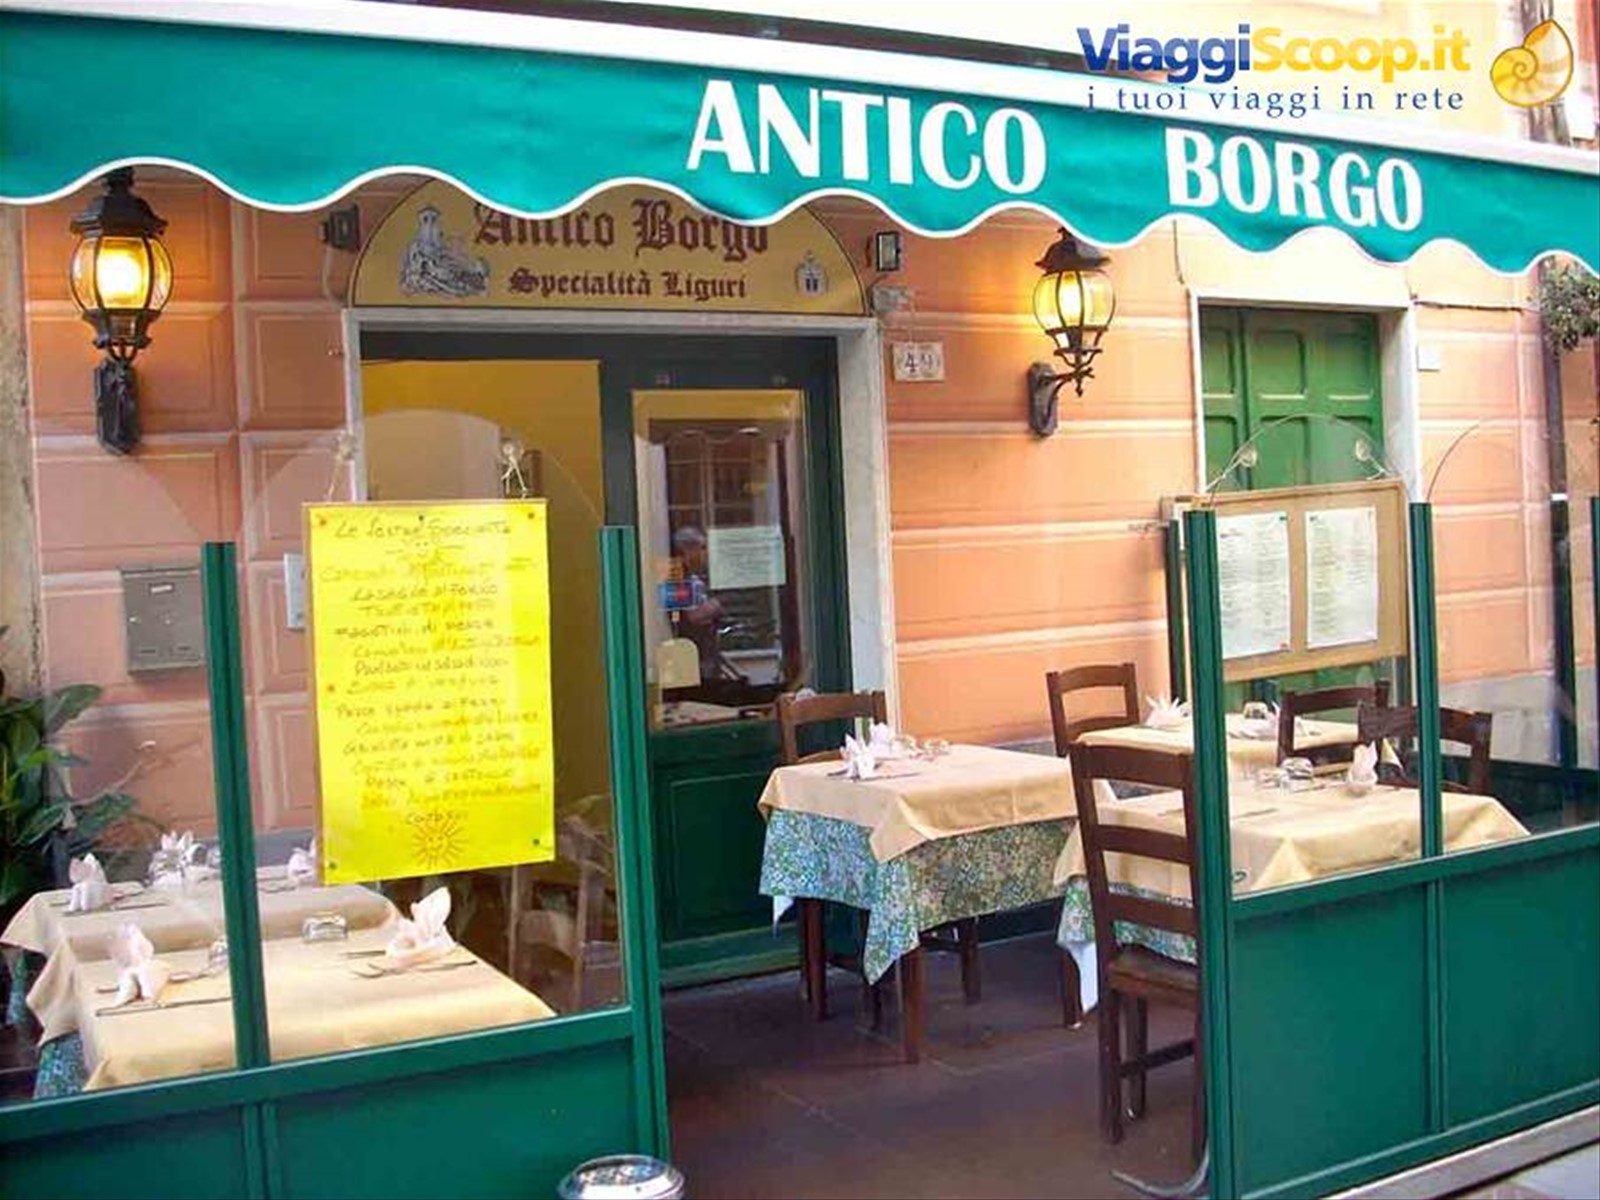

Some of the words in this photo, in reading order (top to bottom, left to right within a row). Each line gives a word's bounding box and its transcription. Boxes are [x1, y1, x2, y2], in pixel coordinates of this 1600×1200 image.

[687, 80, 1047, 194] ANTICO
[1165, 128, 1423, 232] BORGO
[474, 202, 615, 249] Antico
[631, 198, 769, 263] Borgo
[508, 267, 652, 298] Specialità
[660, 270, 748, 301] Liguri
